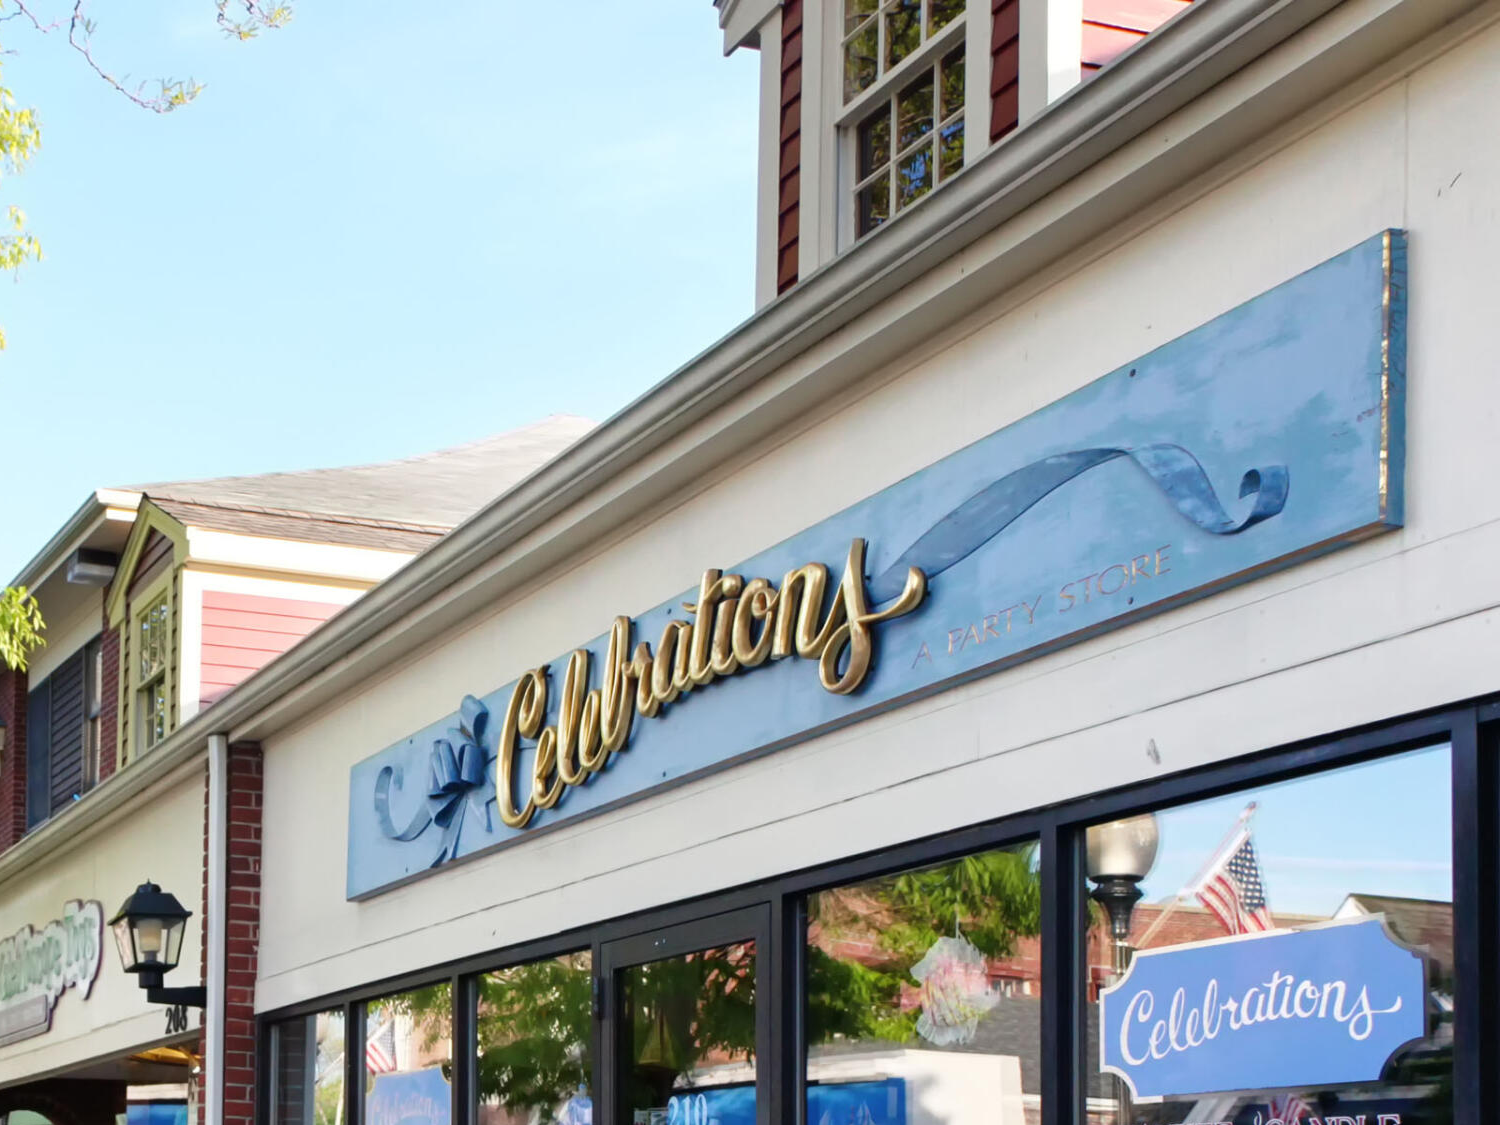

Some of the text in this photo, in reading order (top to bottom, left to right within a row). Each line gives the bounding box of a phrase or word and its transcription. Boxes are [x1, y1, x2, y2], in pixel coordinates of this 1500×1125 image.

[912, 544, 1171, 669] A PARTY STORE
[497, 537, 928, 829] Celebrations
[165, 1005, 188, 1034] 208
[1120, 970, 1402, 1066] Celebrations
